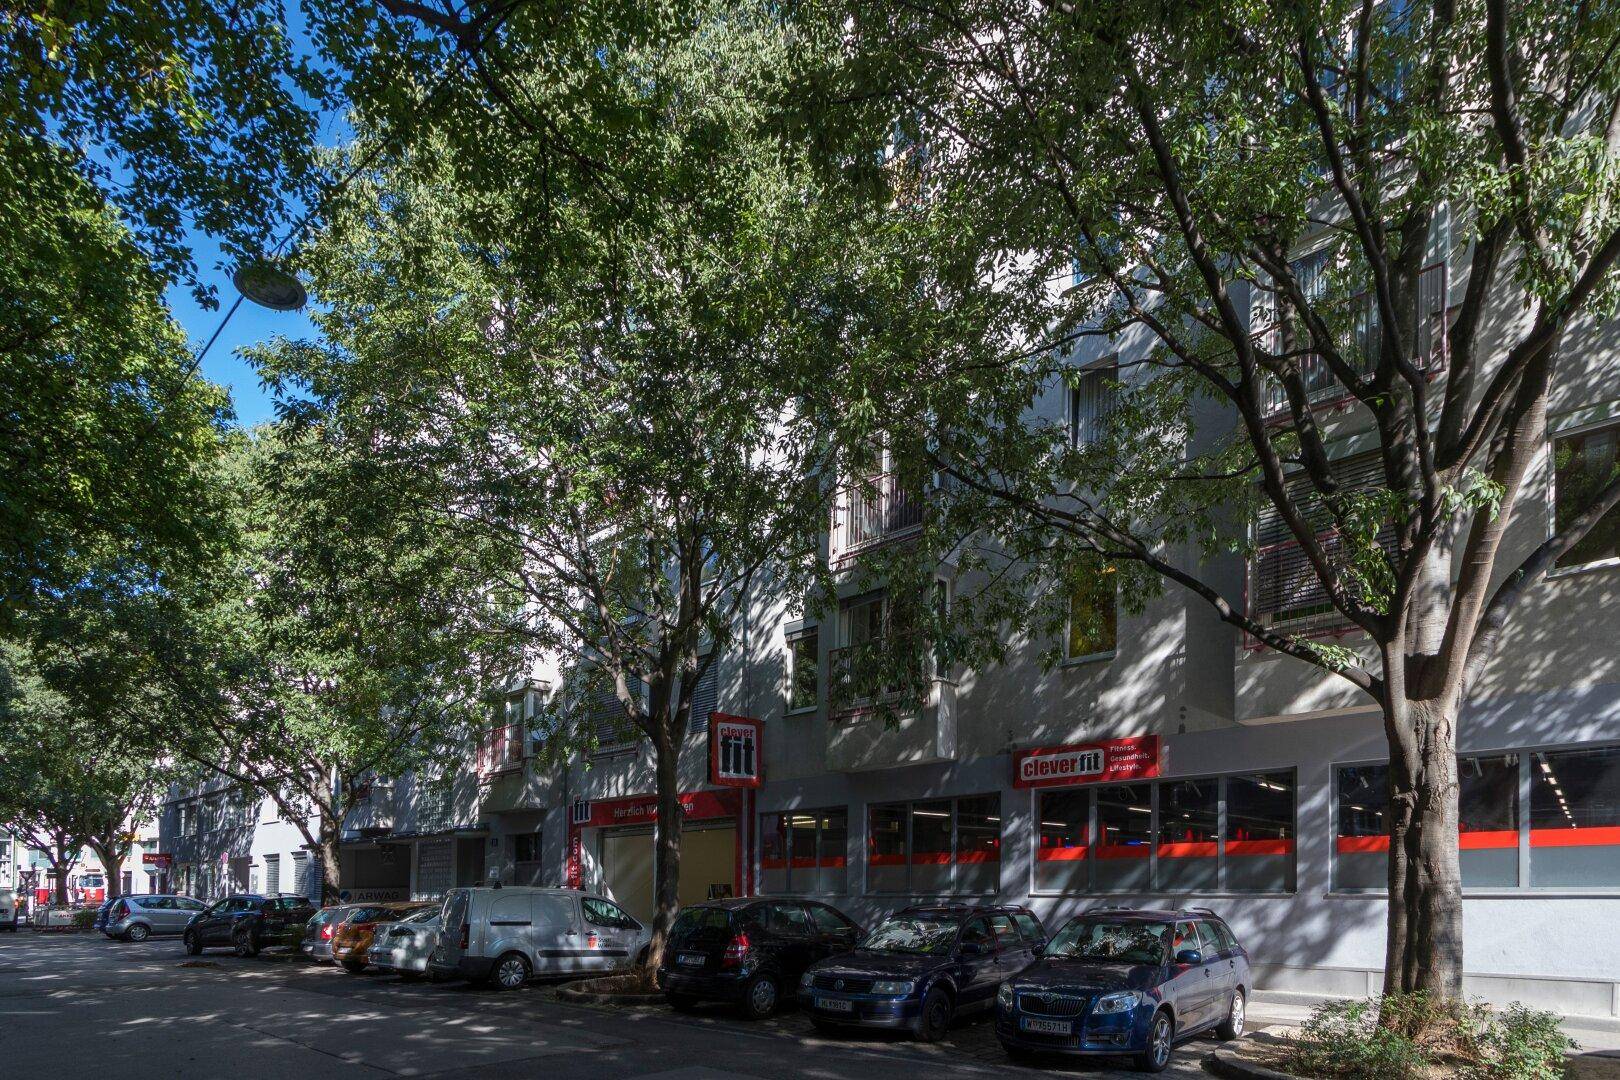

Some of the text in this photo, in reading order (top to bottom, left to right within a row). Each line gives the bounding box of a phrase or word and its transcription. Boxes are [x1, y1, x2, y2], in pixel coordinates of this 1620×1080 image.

[721, 727, 753, 737] clever
[721, 736, 754, 775] fit
[614, 805, 644, 818] Herzlich
